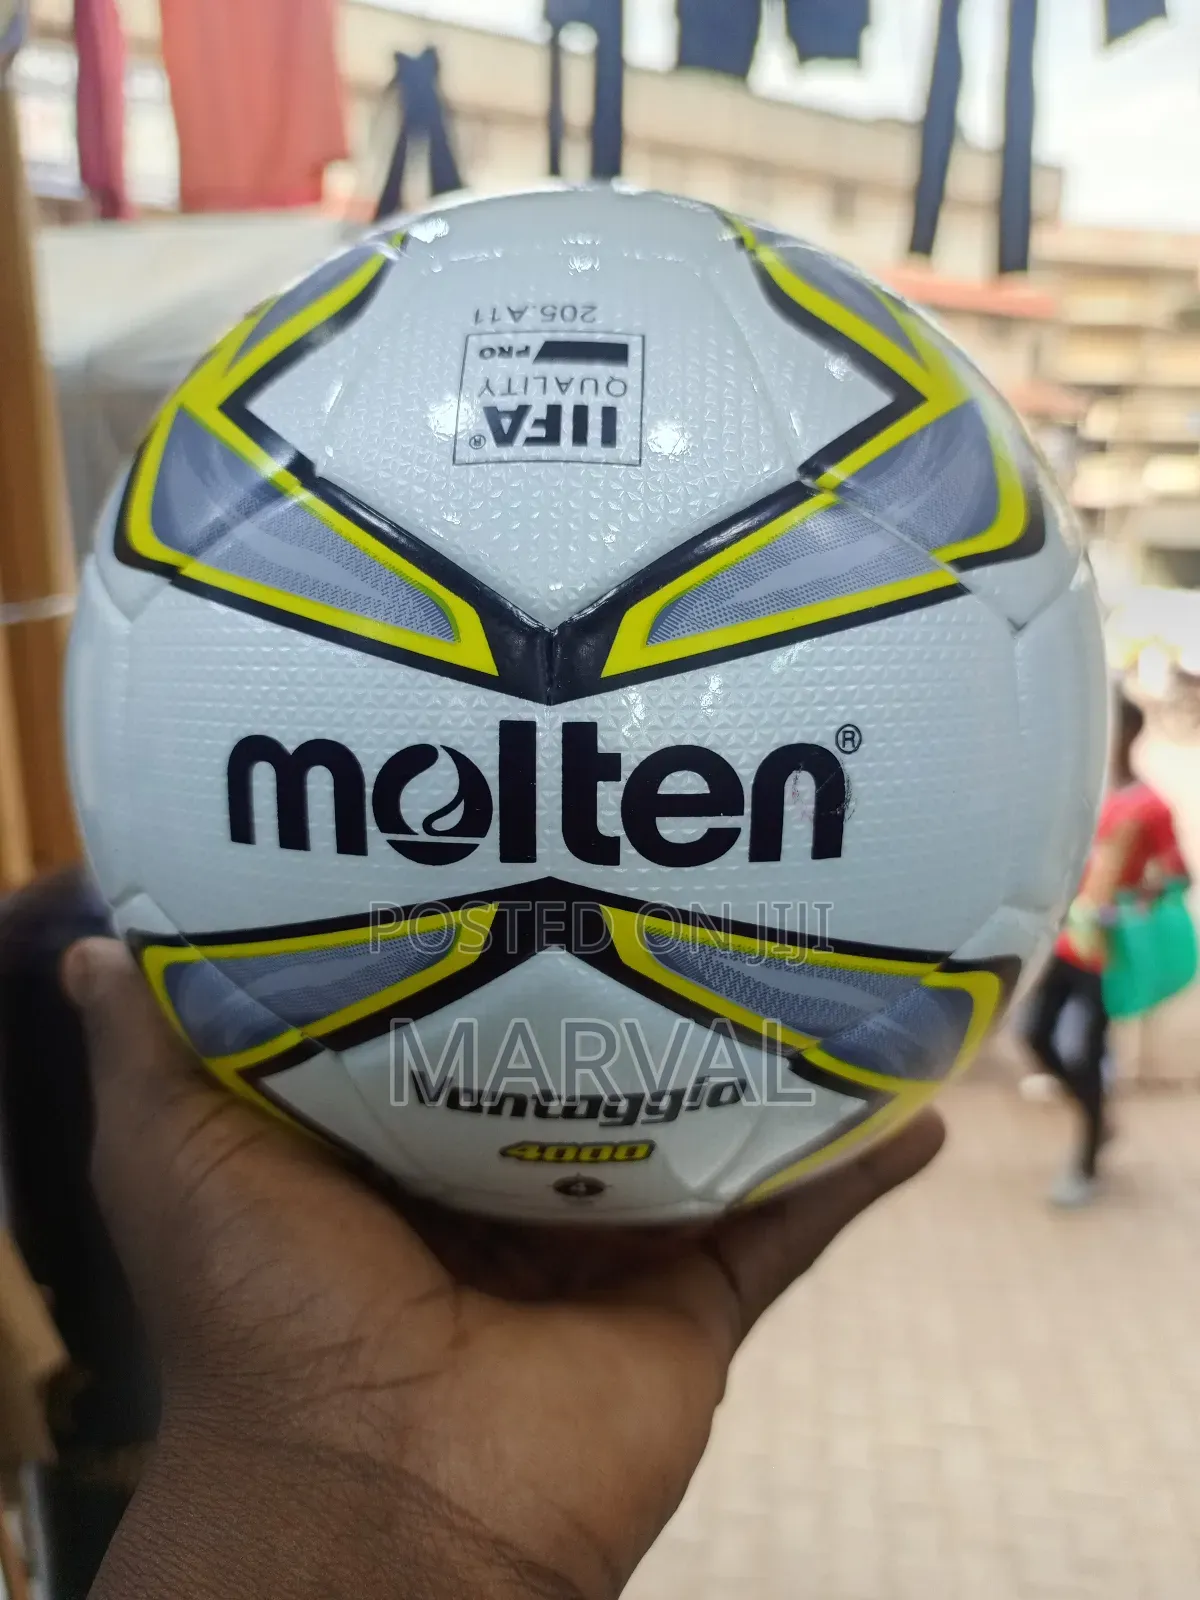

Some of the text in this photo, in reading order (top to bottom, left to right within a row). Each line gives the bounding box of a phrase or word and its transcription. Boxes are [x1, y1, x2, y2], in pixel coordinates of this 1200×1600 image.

[473, 304, 598, 325] 205.A11
[478, 345, 532, 360] PRO
[477, 375, 628, 398] QUALITY
[500, 1139, 656, 1164] 4000
